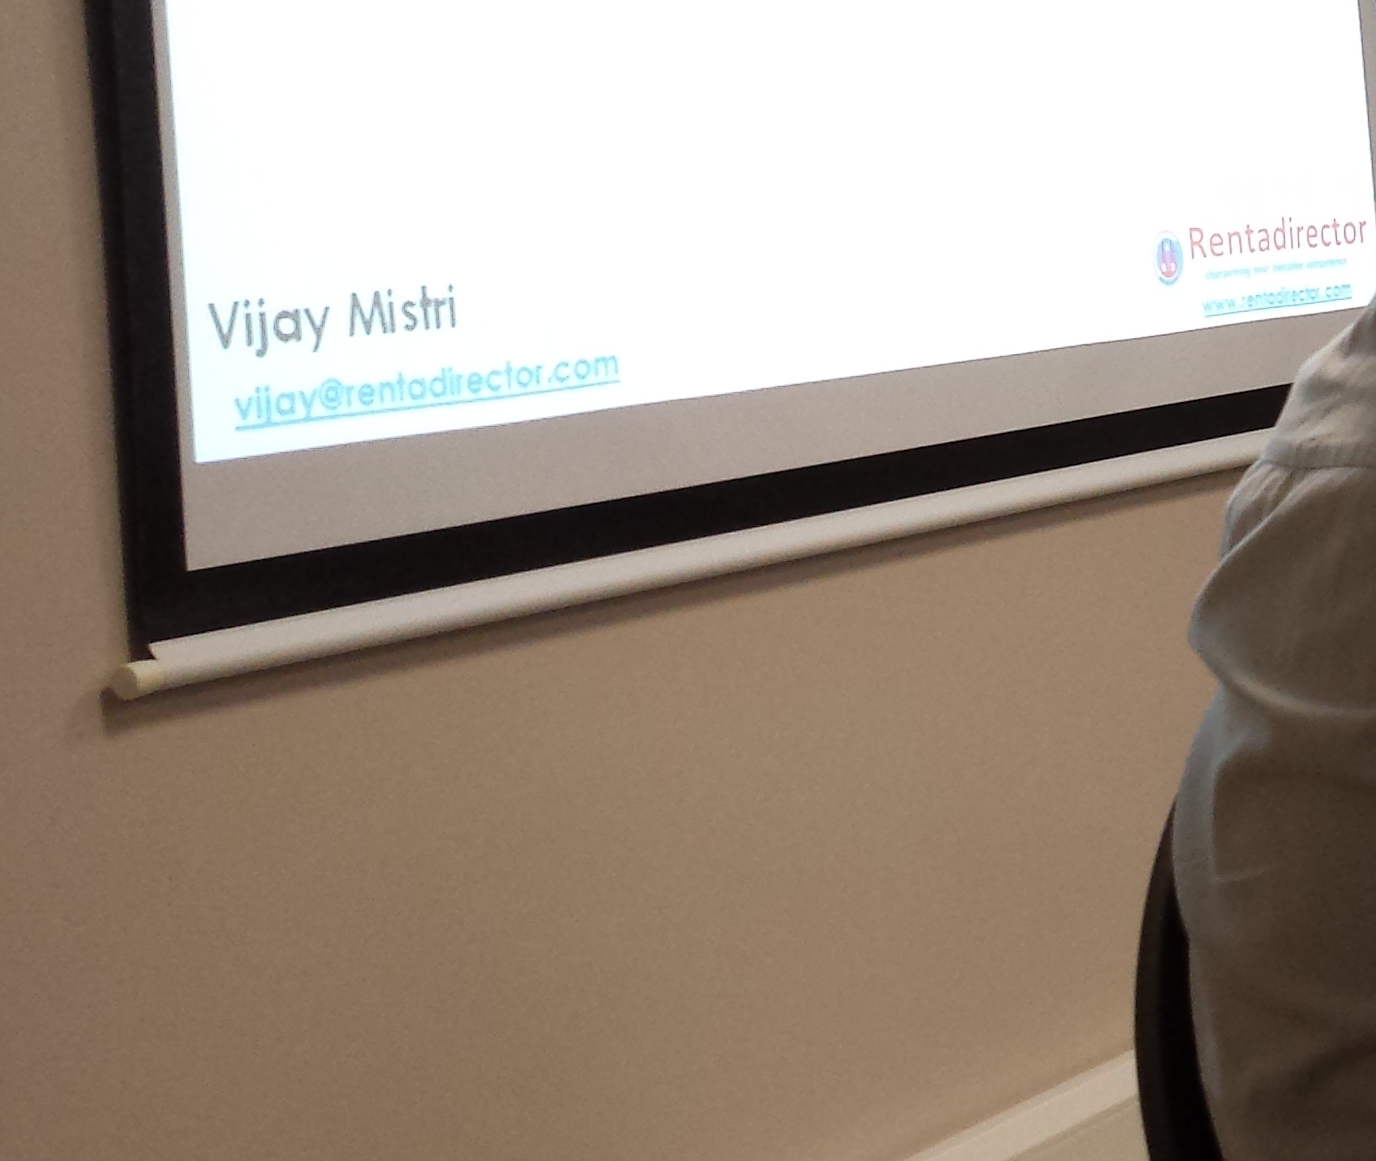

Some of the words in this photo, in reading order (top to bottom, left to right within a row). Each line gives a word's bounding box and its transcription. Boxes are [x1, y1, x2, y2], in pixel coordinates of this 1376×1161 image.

[1188, 215, 1367, 260] Rentadirector
[207, 297, 330, 358] Vijay
[348, 284, 457, 337] Mistri
[234, 354, 620, 426] vijay@rentadirector.com
